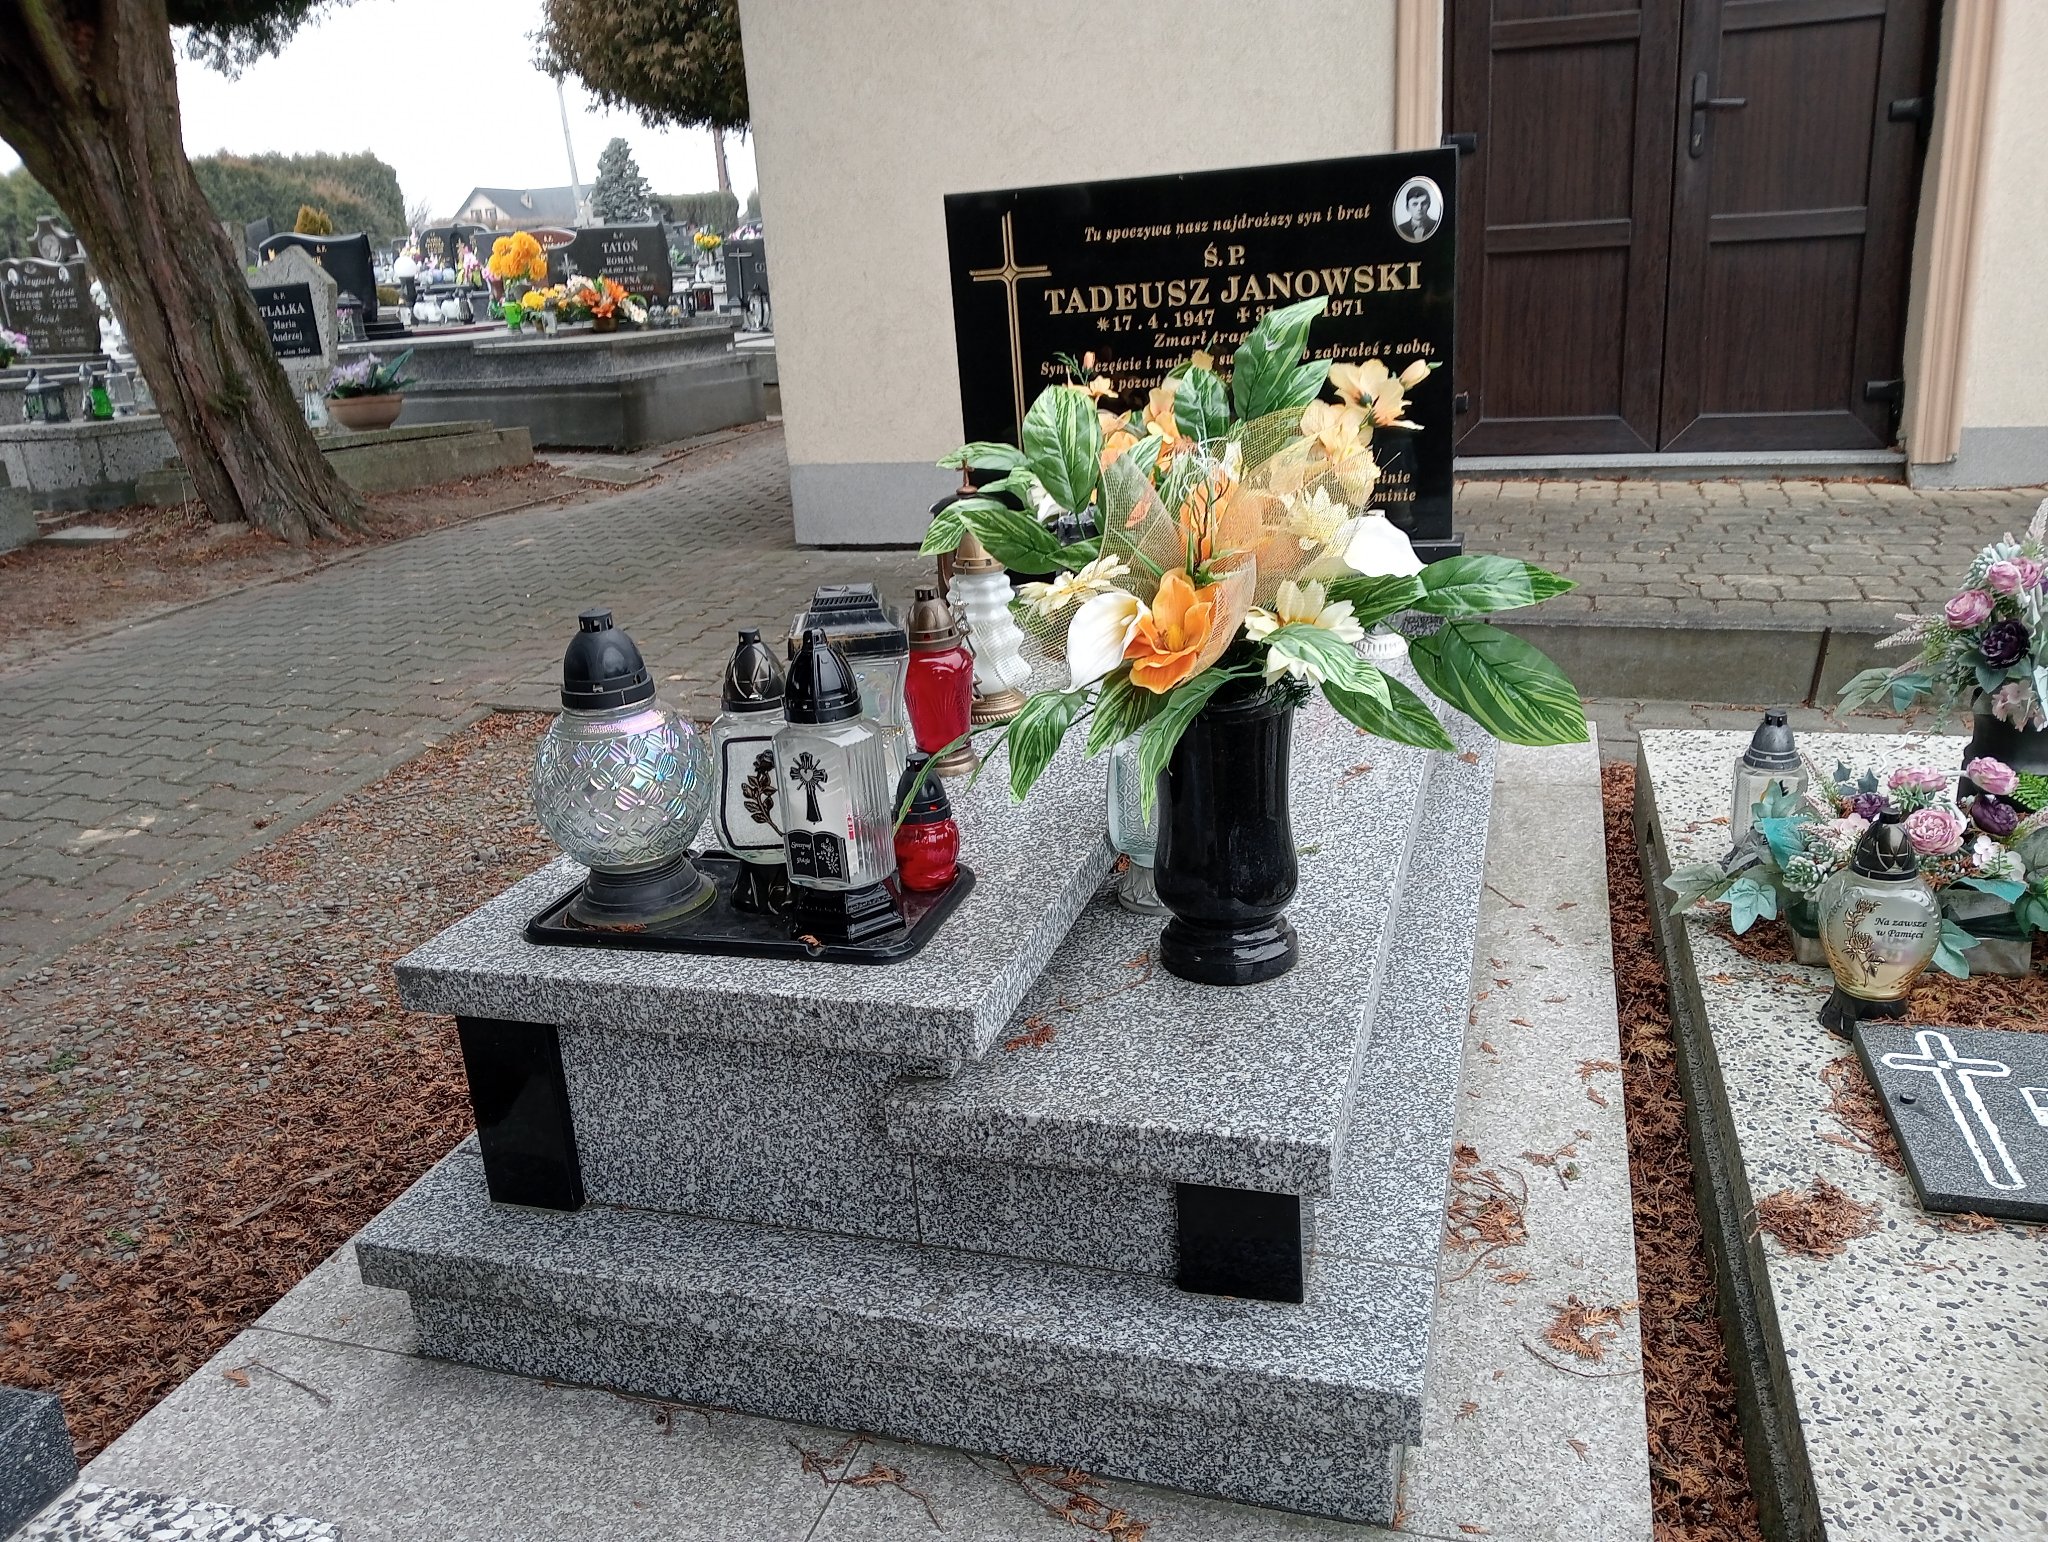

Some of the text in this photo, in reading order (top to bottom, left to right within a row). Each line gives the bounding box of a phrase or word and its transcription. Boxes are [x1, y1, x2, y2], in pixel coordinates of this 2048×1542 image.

[1084, 203, 1371, 243] Tu spoczywa nasz najdroższy syn i brat
[1203, 241, 1246, 268] Ś. P.
[1044, 260, 1423, 316] TADEUSZ JANOWSKI
[272, 319, 297, 331] Maria
[1153, 330, 1208, 348] Zmarł
[1146, 355, 1151, 370] i
[1314, 340, 1381, 360] zabrałeś
[1383, 343, 1392, 356] z
[1396, 338, 1436, 356] sobą,
[1118, 374, 1162, 393] pozost
[1892, 919, 1927, 927] zawsze
[1888, 930, 1925, 939] Pamięci
